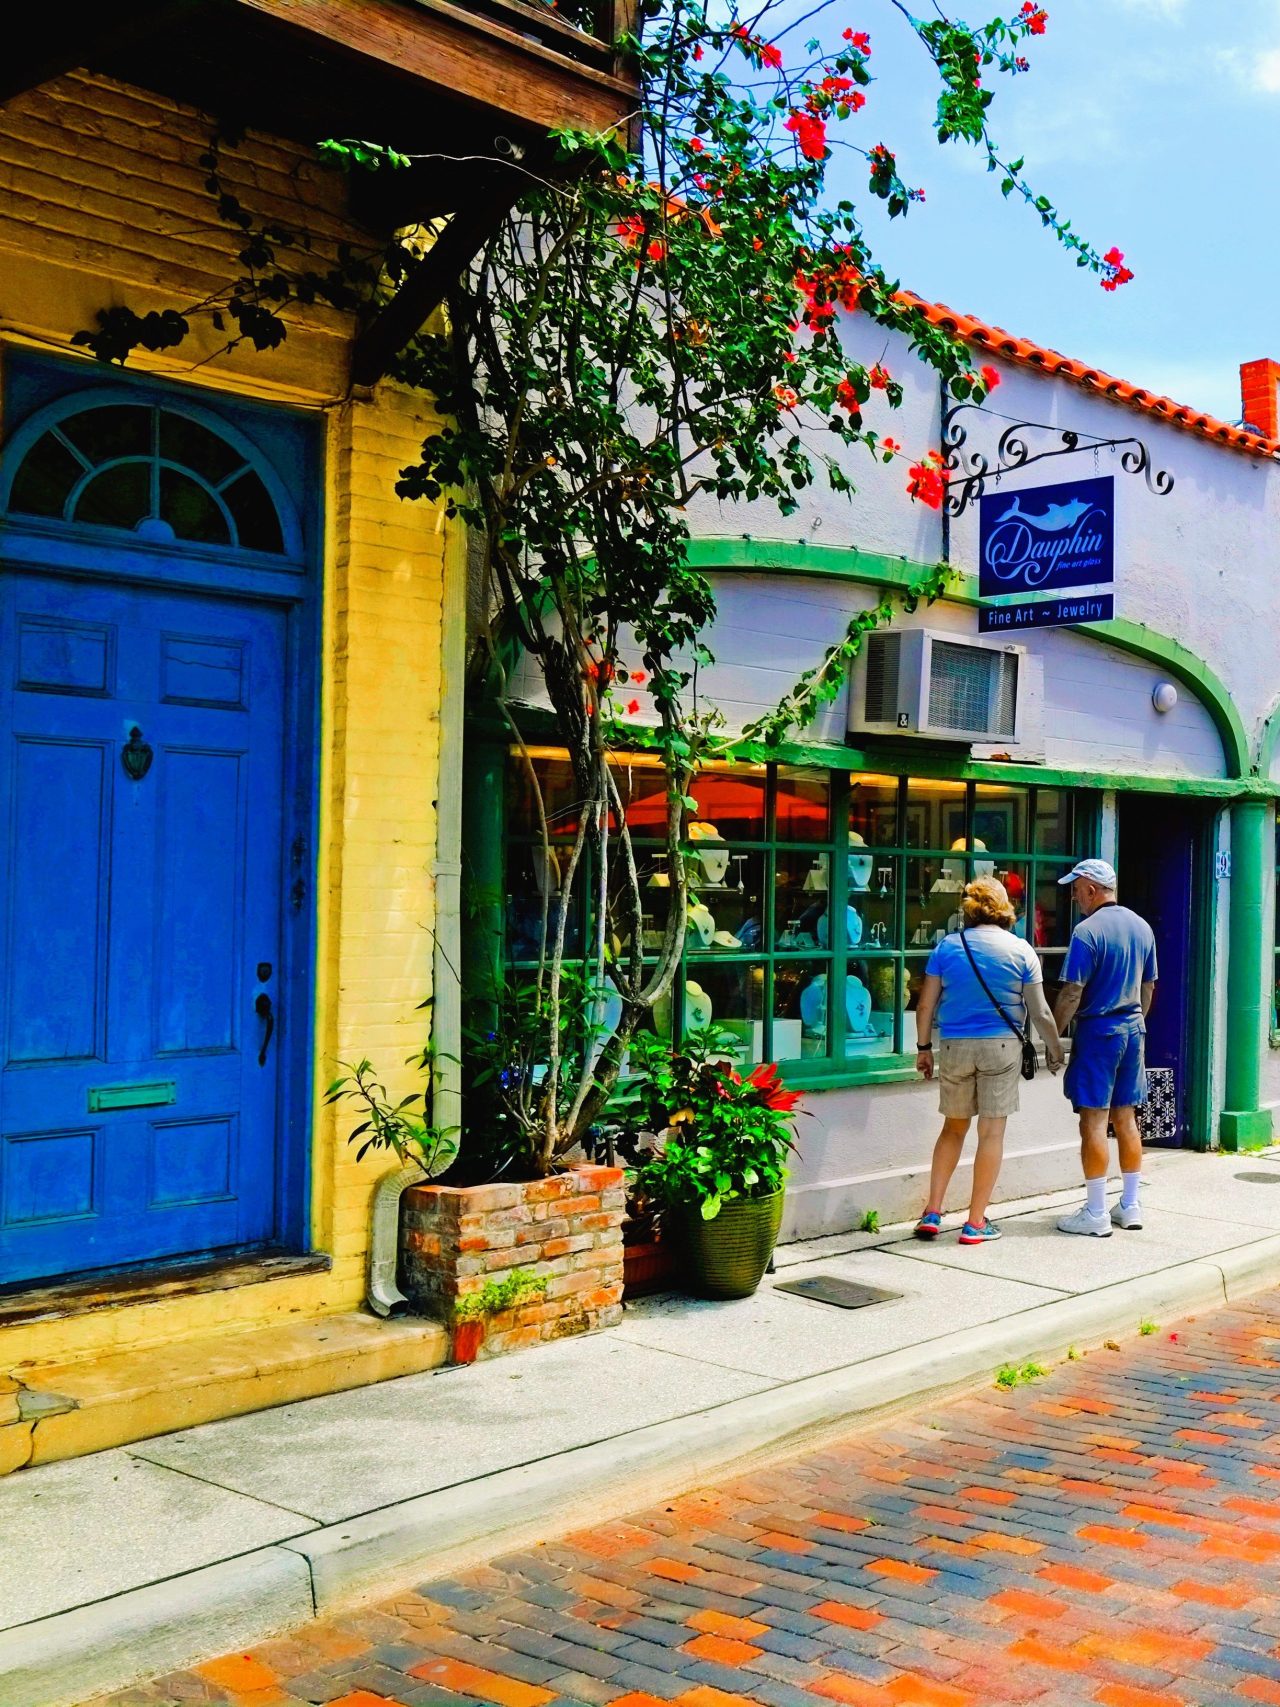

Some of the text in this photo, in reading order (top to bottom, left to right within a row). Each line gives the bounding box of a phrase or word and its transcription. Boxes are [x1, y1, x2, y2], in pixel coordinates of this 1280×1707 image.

[984, 509, 1106, 585] Dauphin
[988, 611, 1011, 625] Fine
[1015, 608, 1034, 622] Art
[1057, 601, 1103, 618] Jewelry
